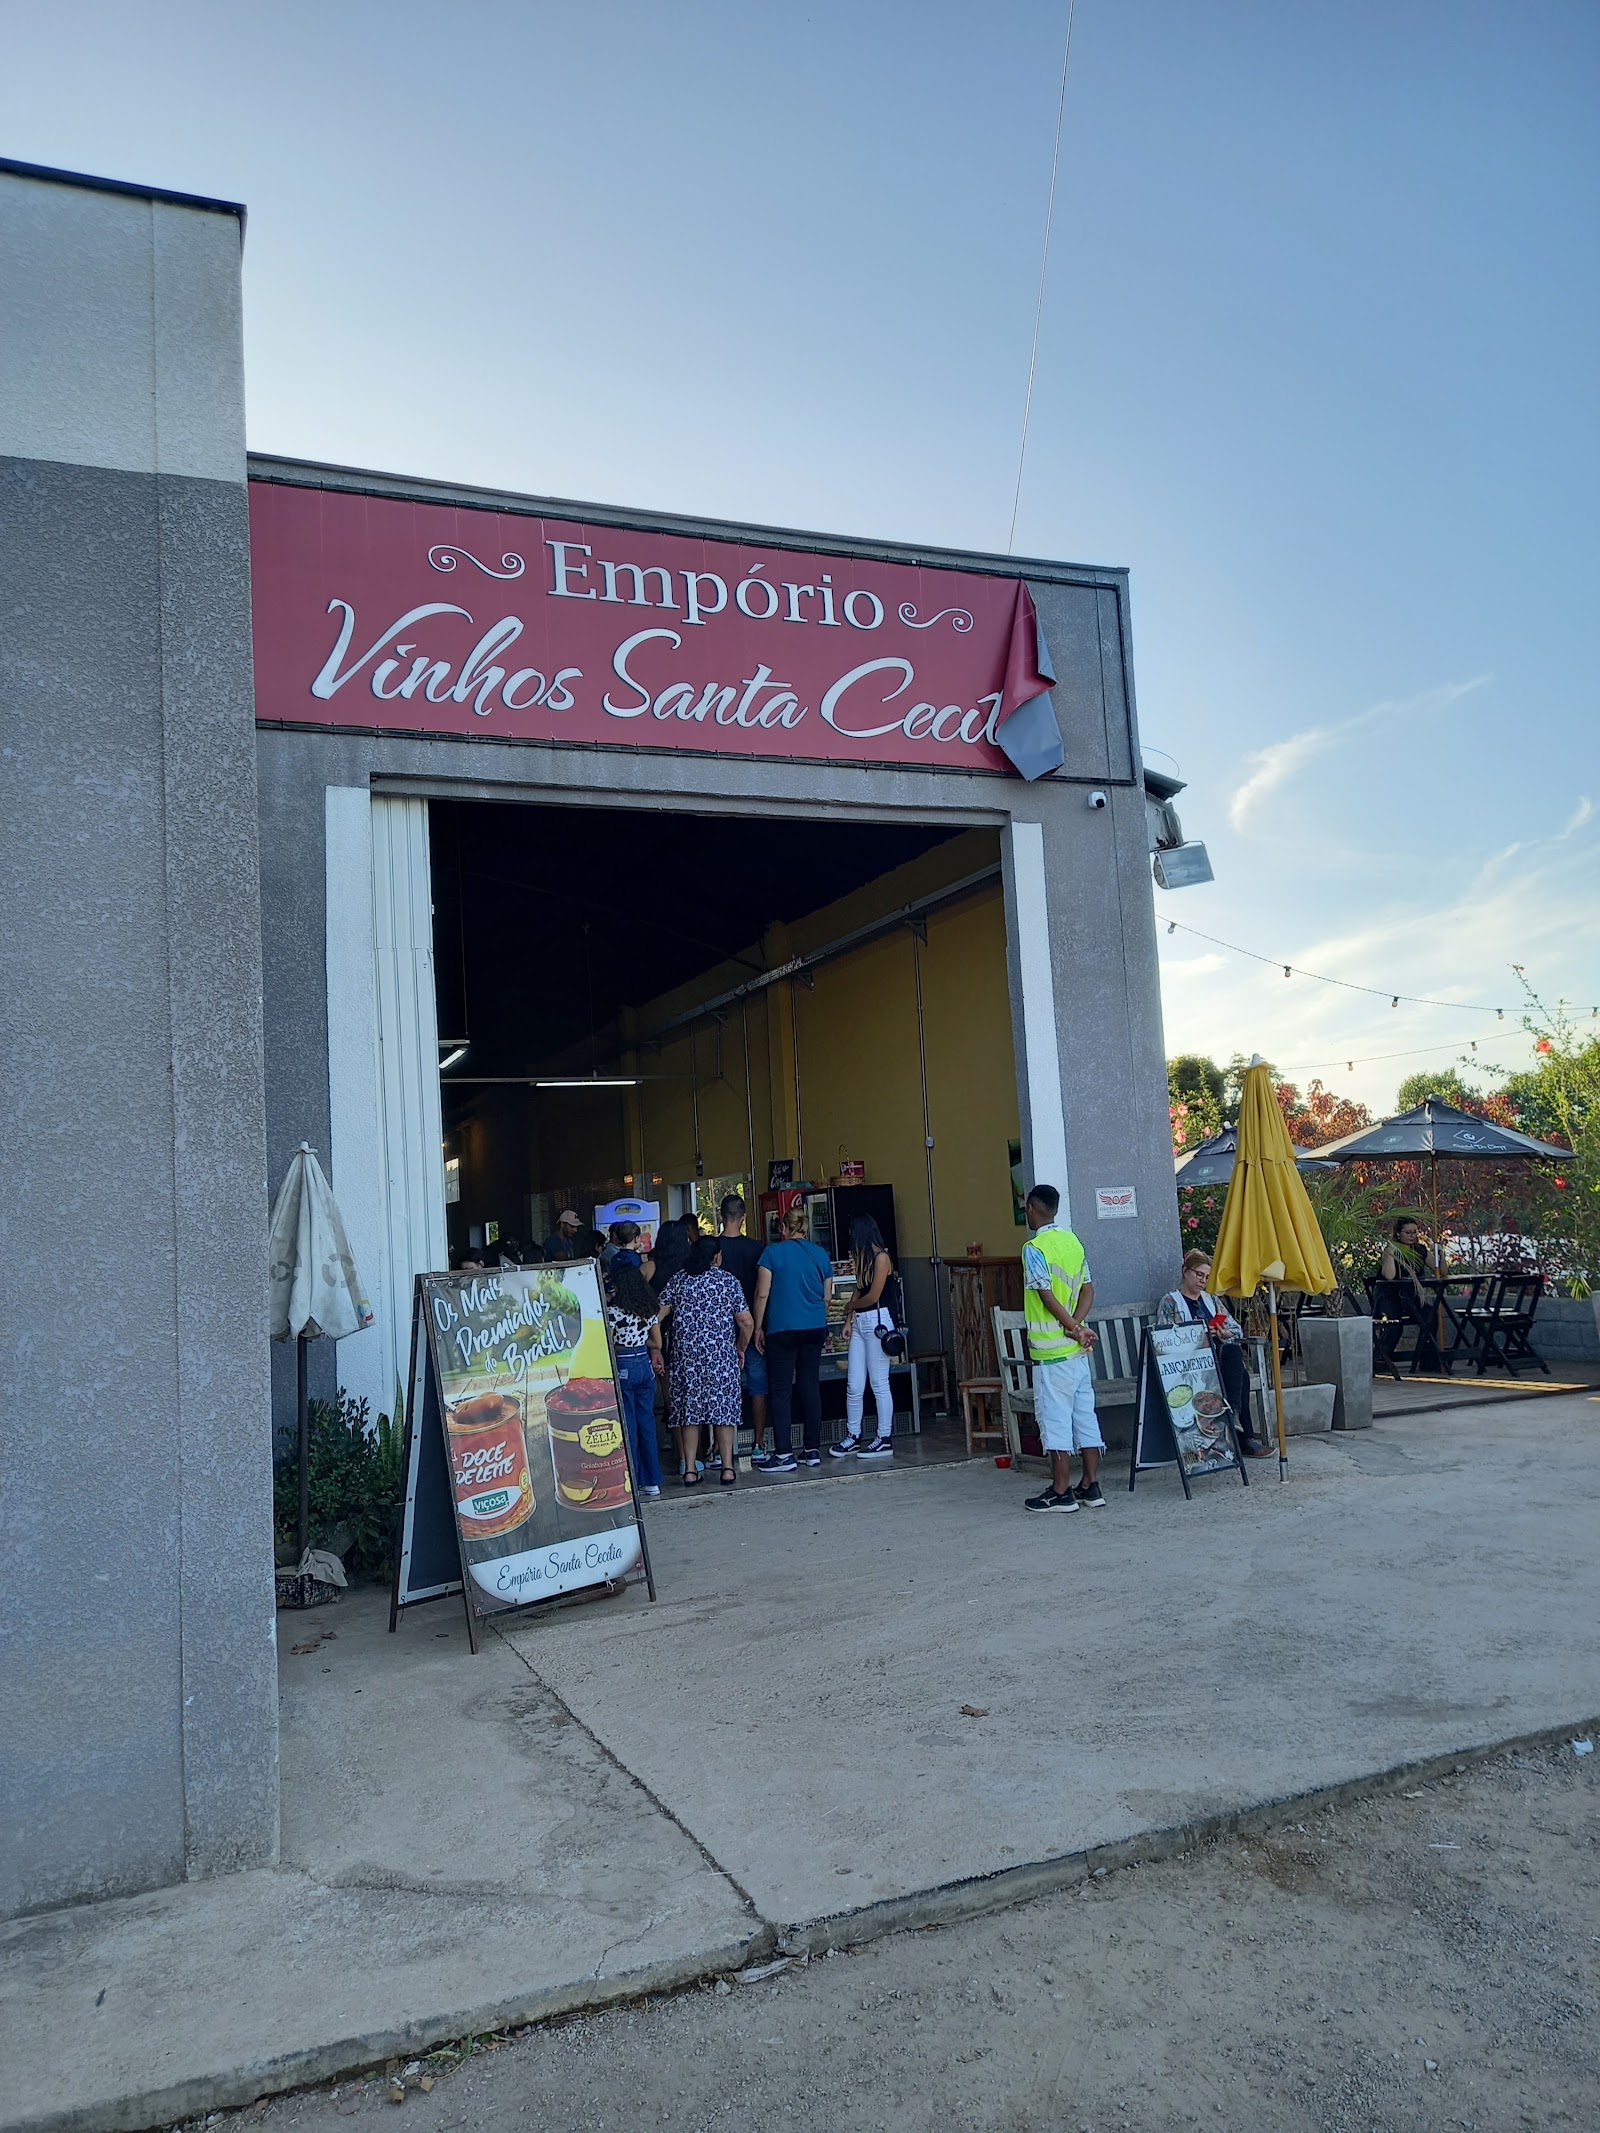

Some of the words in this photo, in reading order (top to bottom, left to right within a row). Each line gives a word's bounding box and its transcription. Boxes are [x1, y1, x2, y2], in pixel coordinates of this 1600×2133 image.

[545, 539, 885, 631] Empório
[310, 597, 585, 717] Vinhos
[602, 627, 809, 730] Santa
[434, 1297, 459, 1332] Os
[460, 1277, 504, 1318] Mais
[455, 1287, 551, 1367] Premiados
[484, 1351, 497, 1374] do
[502, 1314, 572, 1383] Brasil!
[461, 1440, 507, 1468] DOCE
[585, 1431, 617, 1444] ZÉLIA
[455, 1468, 476, 1485] DE
[475, 1452, 516, 1484] LEITE
[496, 1564, 543, 1593] Empório
[544, 1552, 583, 1579] Santa
[584, 1542, 623, 1569] Cecília
